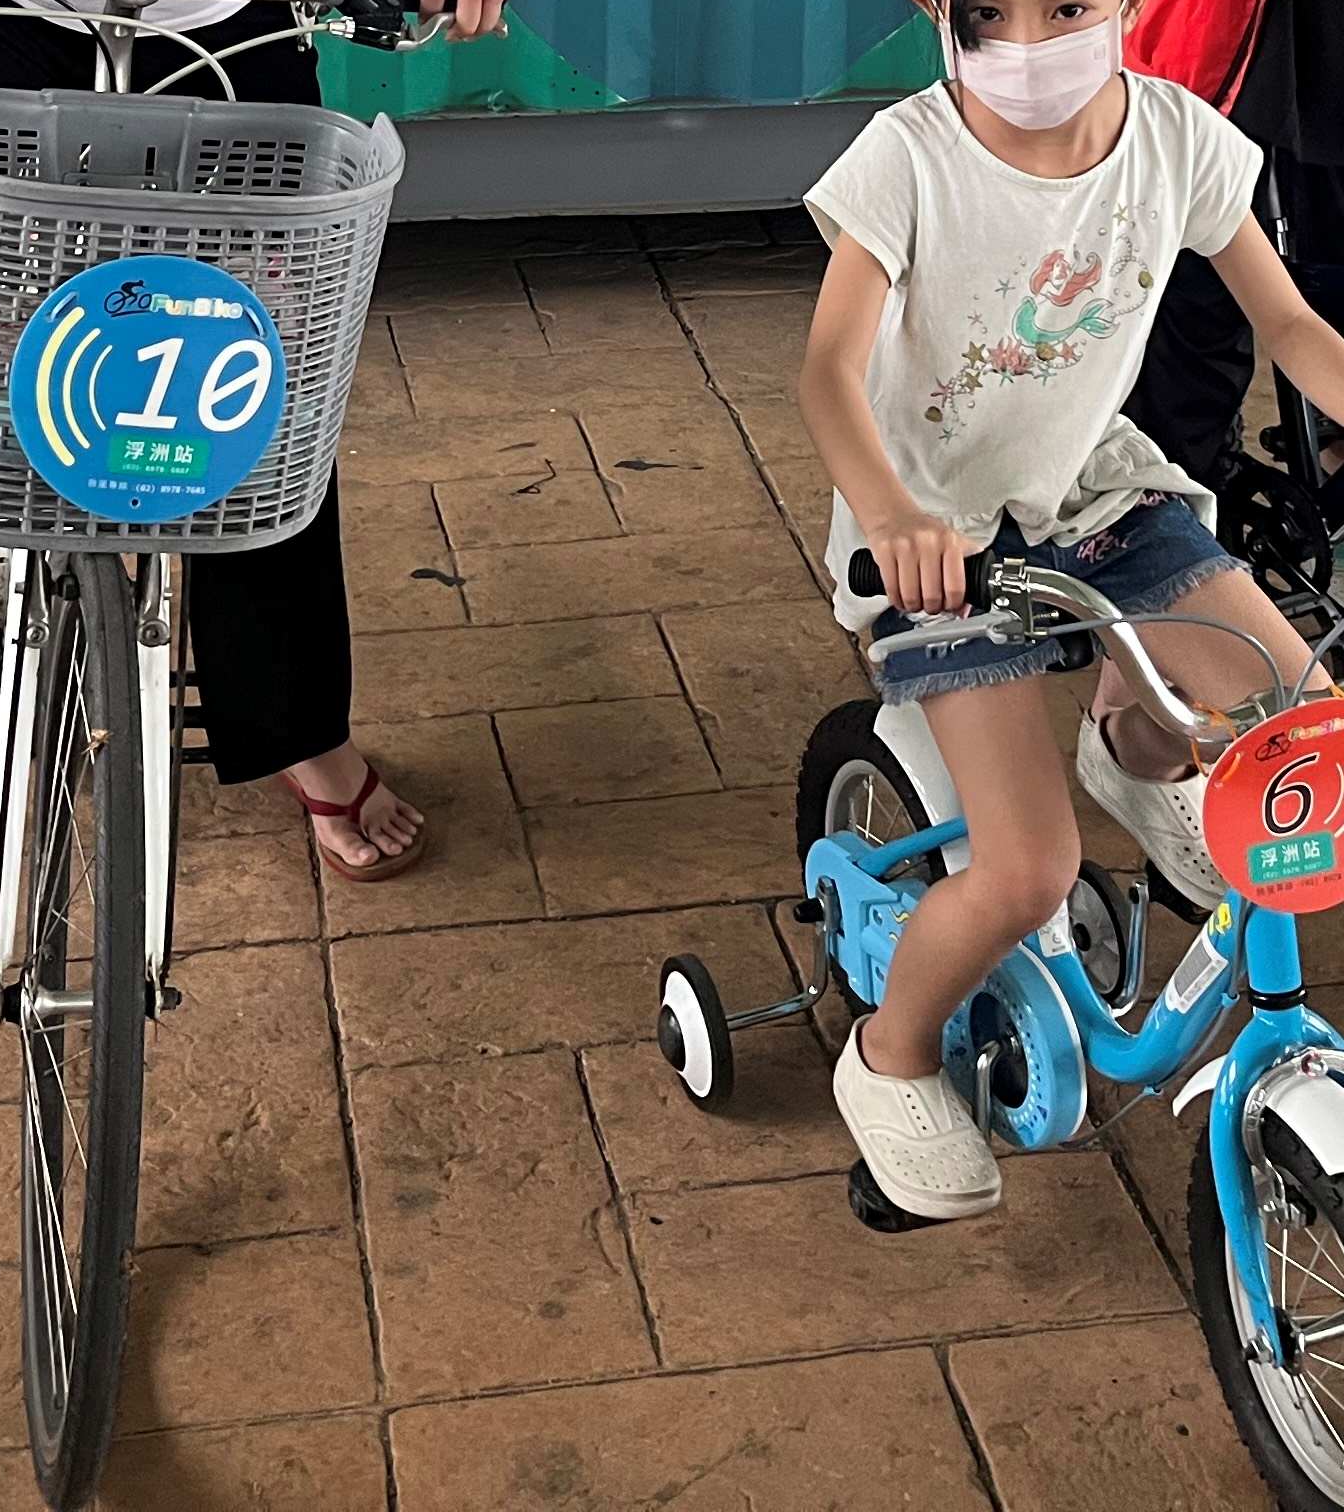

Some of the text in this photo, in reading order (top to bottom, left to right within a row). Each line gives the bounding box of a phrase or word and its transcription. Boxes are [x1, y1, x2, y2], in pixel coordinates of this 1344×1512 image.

[150, 294, 243, 319] FunBike
[115, 338, 273, 432] 10
[123, 440, 195, 464] 浮洲站
[1262, 751, 1320, 838] 6
[1260, 840, 1321, 868] 浮洲站
